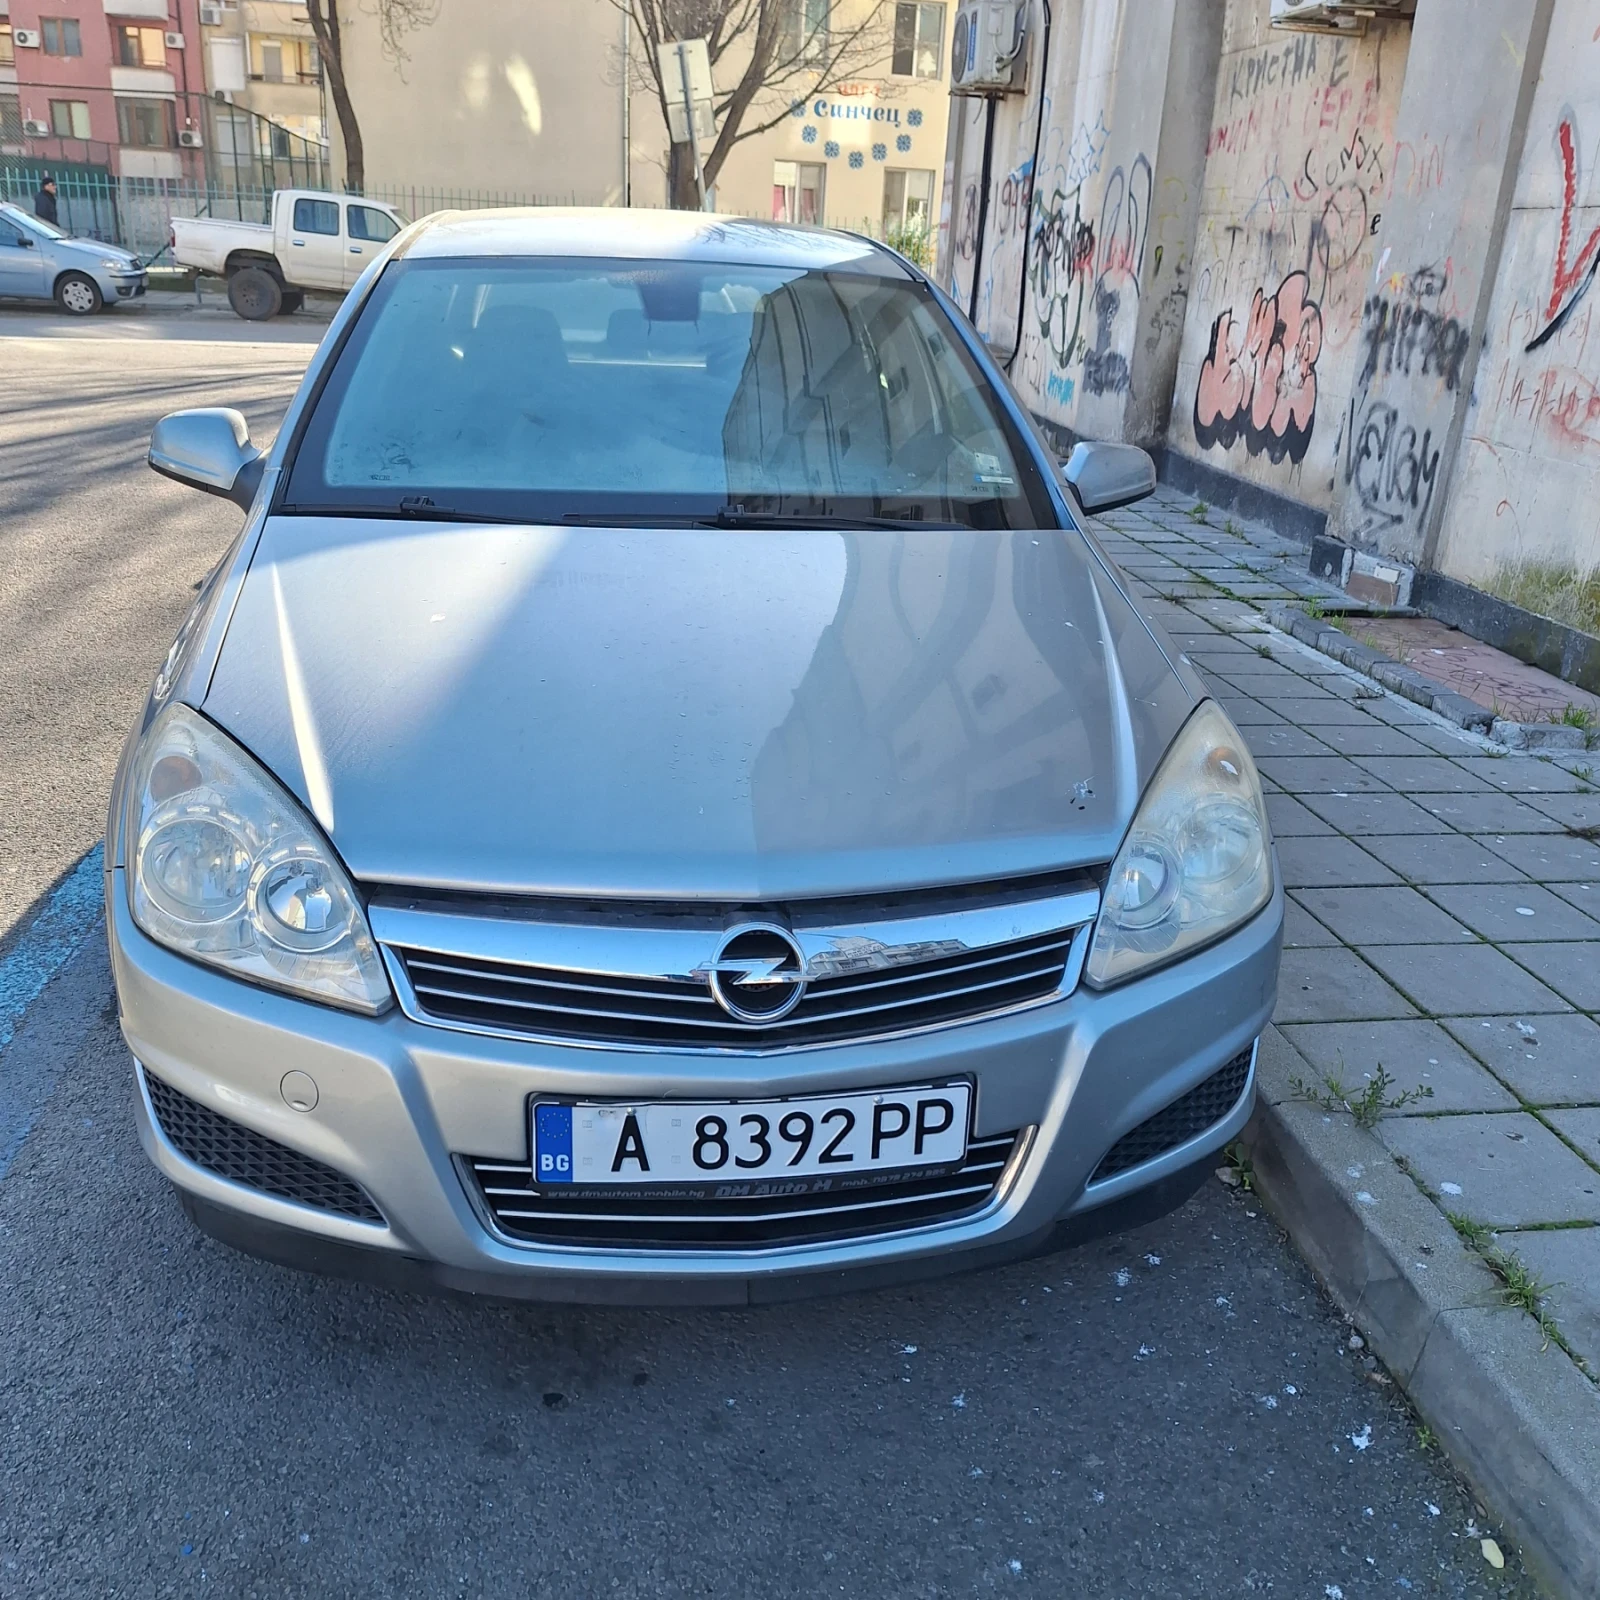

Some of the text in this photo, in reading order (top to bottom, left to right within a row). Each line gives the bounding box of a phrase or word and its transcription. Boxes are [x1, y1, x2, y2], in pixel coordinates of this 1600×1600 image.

[814, 99, 901, 128] Синчец
[611, 1098, 954, 1172] A 8392 PP
[541, 1154, 569, 1171] BG
[714, 1185, 749, 1197] DM
[755, 1182, 806, 1195] Auto
[813, 1179, 832, 1191] M
